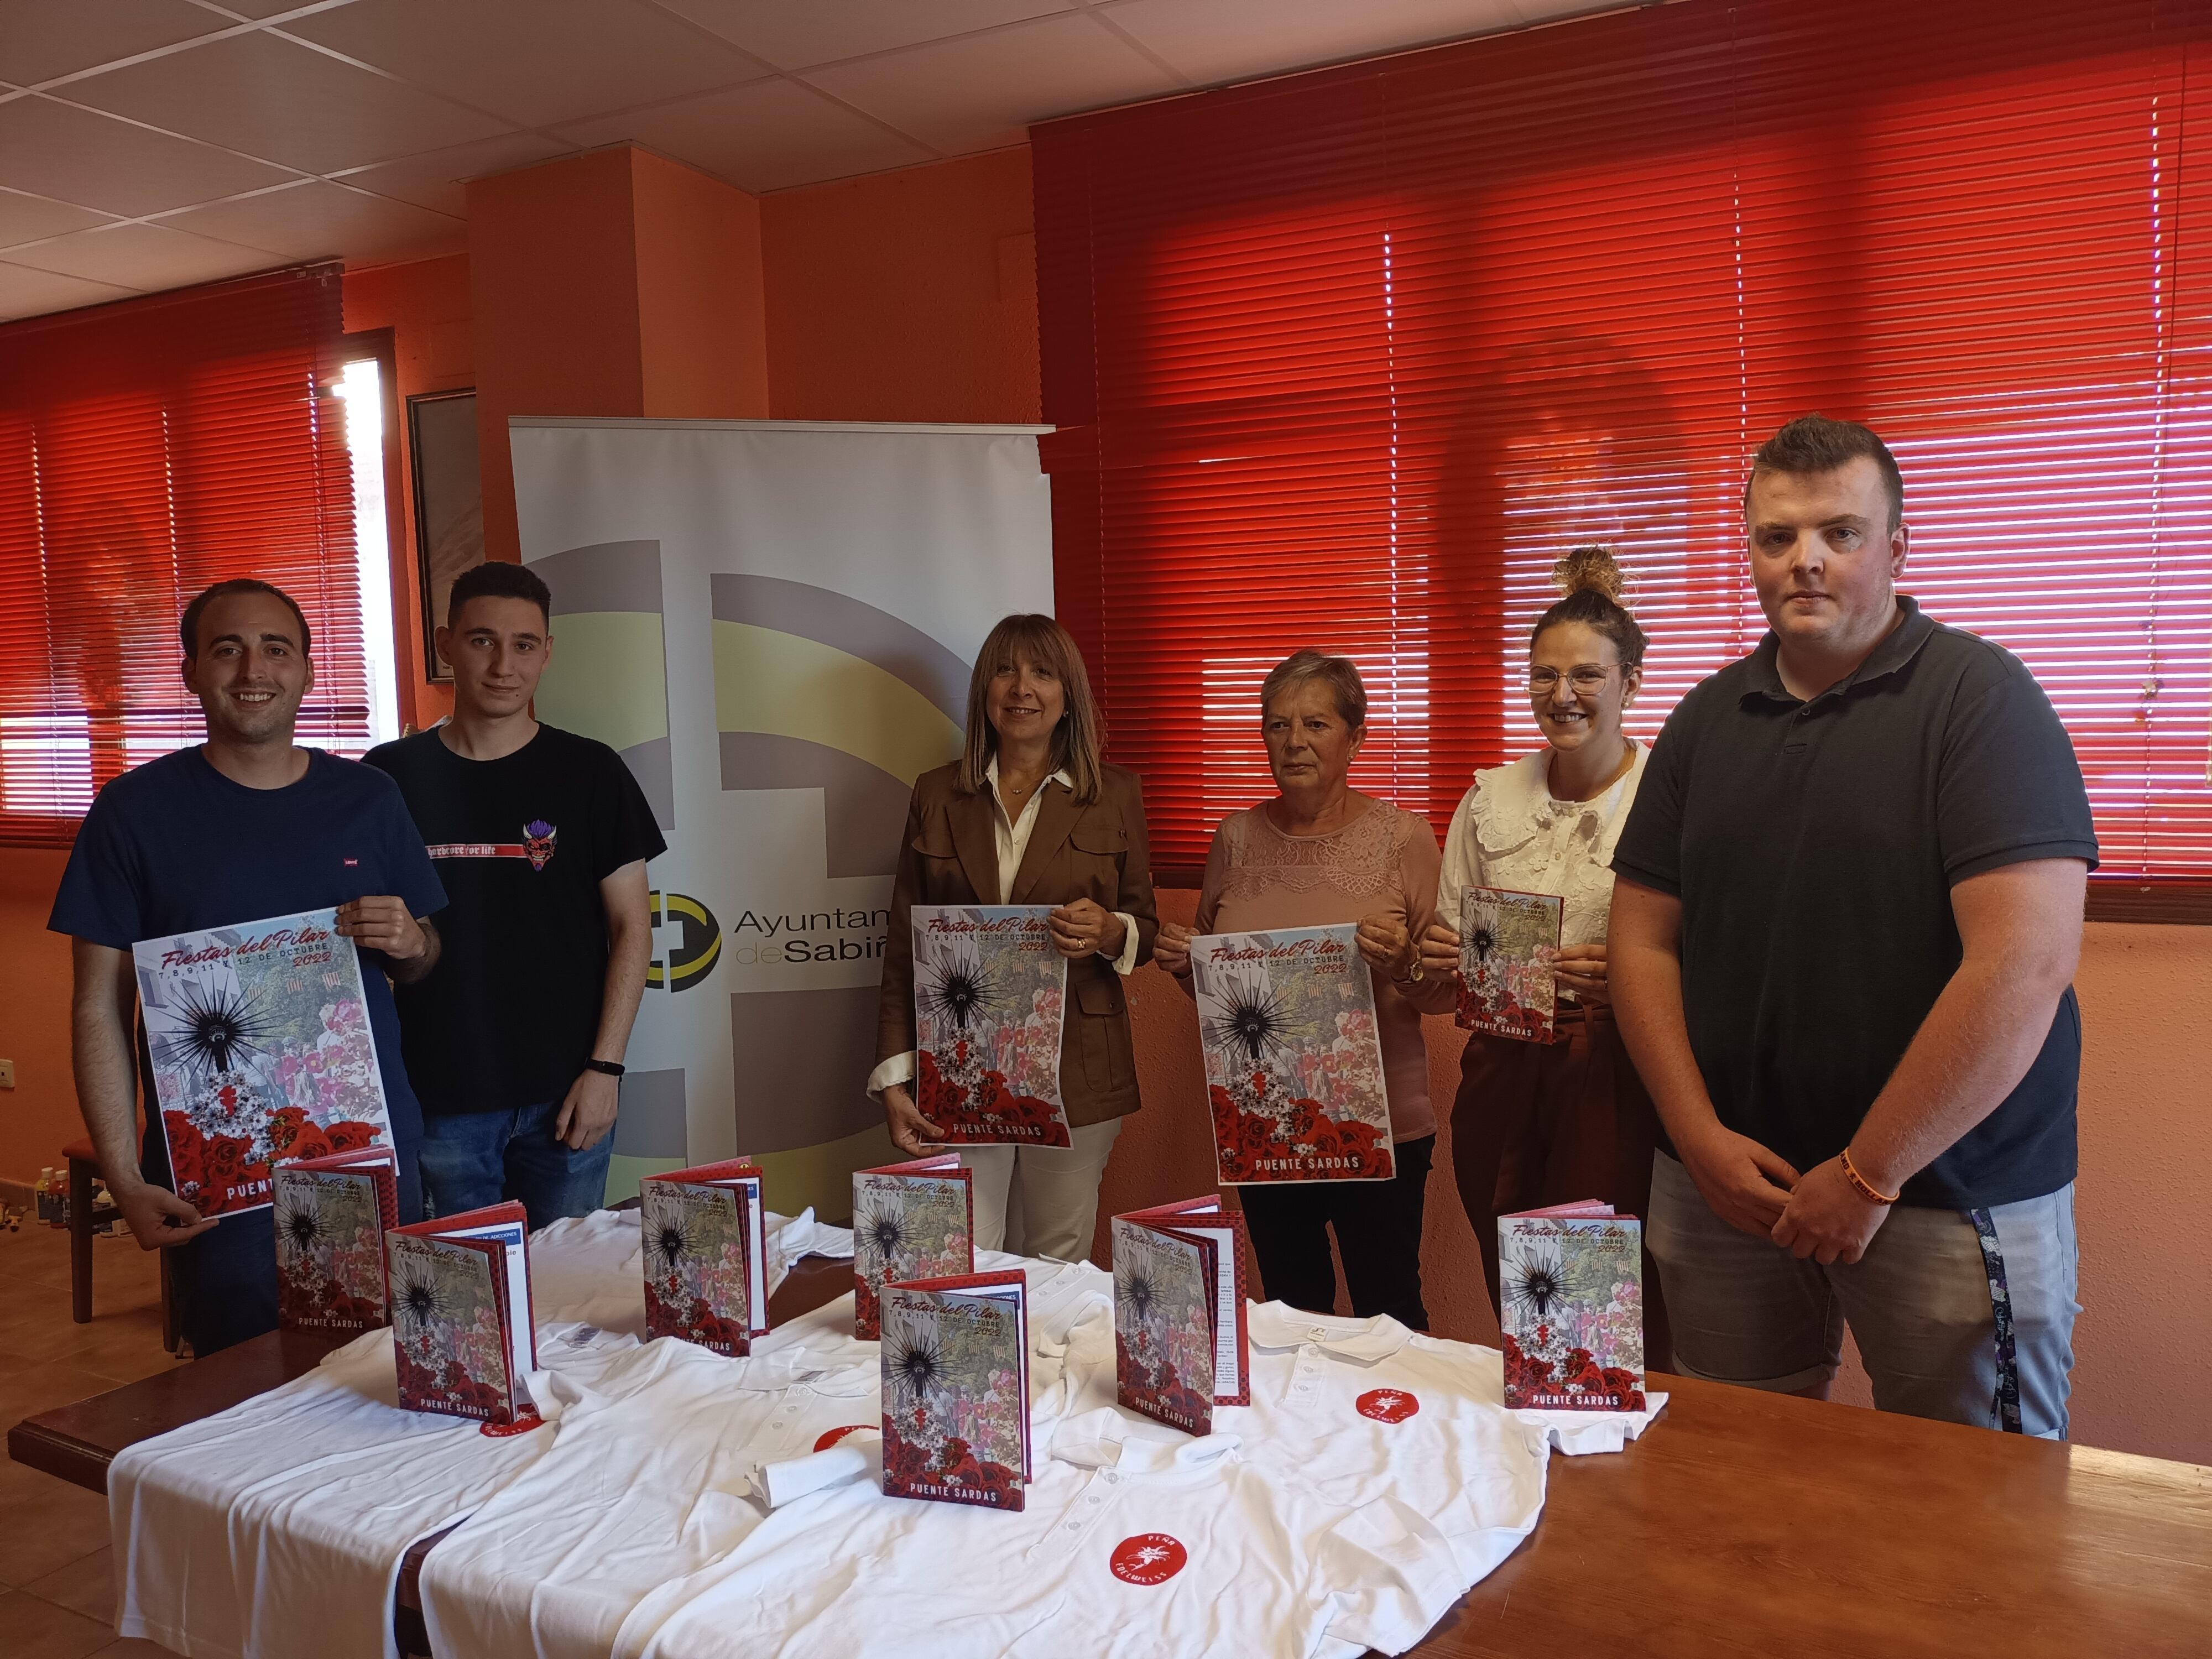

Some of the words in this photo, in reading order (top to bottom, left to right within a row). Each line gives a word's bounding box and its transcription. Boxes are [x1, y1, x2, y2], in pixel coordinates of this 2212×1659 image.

[481, 846, 495, 855] life
[1468, 892, 1497, 904] Fiestas
[1500, 897, 1518, 906] del
[1517, 898, 1548, 909] Pilar
[928, 918, 976, 932] Fiestas
[980, 918, 1006, 931] del
[1006, 917, 1048, 932] Pilar
[161, 946, 232, 969] Fiestas
[236, 936, 274, 954] del
[273, 927, 331, 948] Pilar
[280, 943, 327, 956] OCTUBRE
[1019, 942, 1047, 951] 2022
[1211, 947, 1266, 963] Fiestas
[1269, 942, 1299, 958] del
[1298, 940, 1347, 956] Pilar
[293, 951, 331, 967] 2022
[1304, 956, 1344, 964] OCTUBRE
[1314, 963, 1347, 974] 2022
[1471, 1020, 1496, 1031] PUENTE
[1501, 1025, 1531, 1036] SARDAS
[953, 1124, 993, 1134] PUENTE
[998, 1125, 1041, 1135] SARDAS
[1256, 1159, 1301, 1170] PUENTE
[1308, 1157, 1359, 1168] SARDAS
[227, 1178, 273, 1199] PUENT
[281, 1176, 315, 1186] Fiestas
[317, 1178, 334, 1187] del
[333, 1178, 362, 1190] Pilar
[864, 1180, 902, 1191] Fiestas
[904, 1182, 924, 1192] del
[924, 1183, 955, 1194] Pilar
[649, 1186, 681, 1198] Fiestas
[684, 1189, 701, 1200] del
[700, 1191, 727, 1203] Pilar
[1512, 1225, 1559, 1235] Fiestas
[1562, 1225, 1589, 1236] del
[1588, 1225, 1626, 1237] Pilar
[1120, 1228, 1150, 1244] Fiestas
[1152, 1239, 1166, 1250] del
[1165, 1243, 1192, 1260] Pilar
[395, 1241, 430, 1255] Fiestas
[432, 1248, 450, 1258] del
[449, 1250, 477, 1265] Pilar
[892, 1297, 938, 1311] Fiestas
[940, 1303, 966, 1314] del
[964, 1304, 1003, 1319] Pilar
[299, 1318, 327, 1326] PUENTE
[332, 1319, 363, 1328] SARDAS
[968, 1319, 999, 1327] OCTUBRE
[974, 1328, 1000, 1336] 2022
[1533, 1395, 1571, 1404] PUENTE
[1577, 1396, 1618, 1405] SARDAS
[421, 1399, 451, 1410] PUENTE
[457, 1404, 489, 1416] SARDAS
[1135, 1397, 1161, 1415] PUENTE
[1165, 1408, 1193, 1428] SARDAS
[910, 1483, 948, 1496] PUENTE
[955, 1488, 996, 1501] SARDAS
[1148, 1536, 1175, 1546] PEÑA
[1115, 1562, 1167, 1583] EDELWEISS
